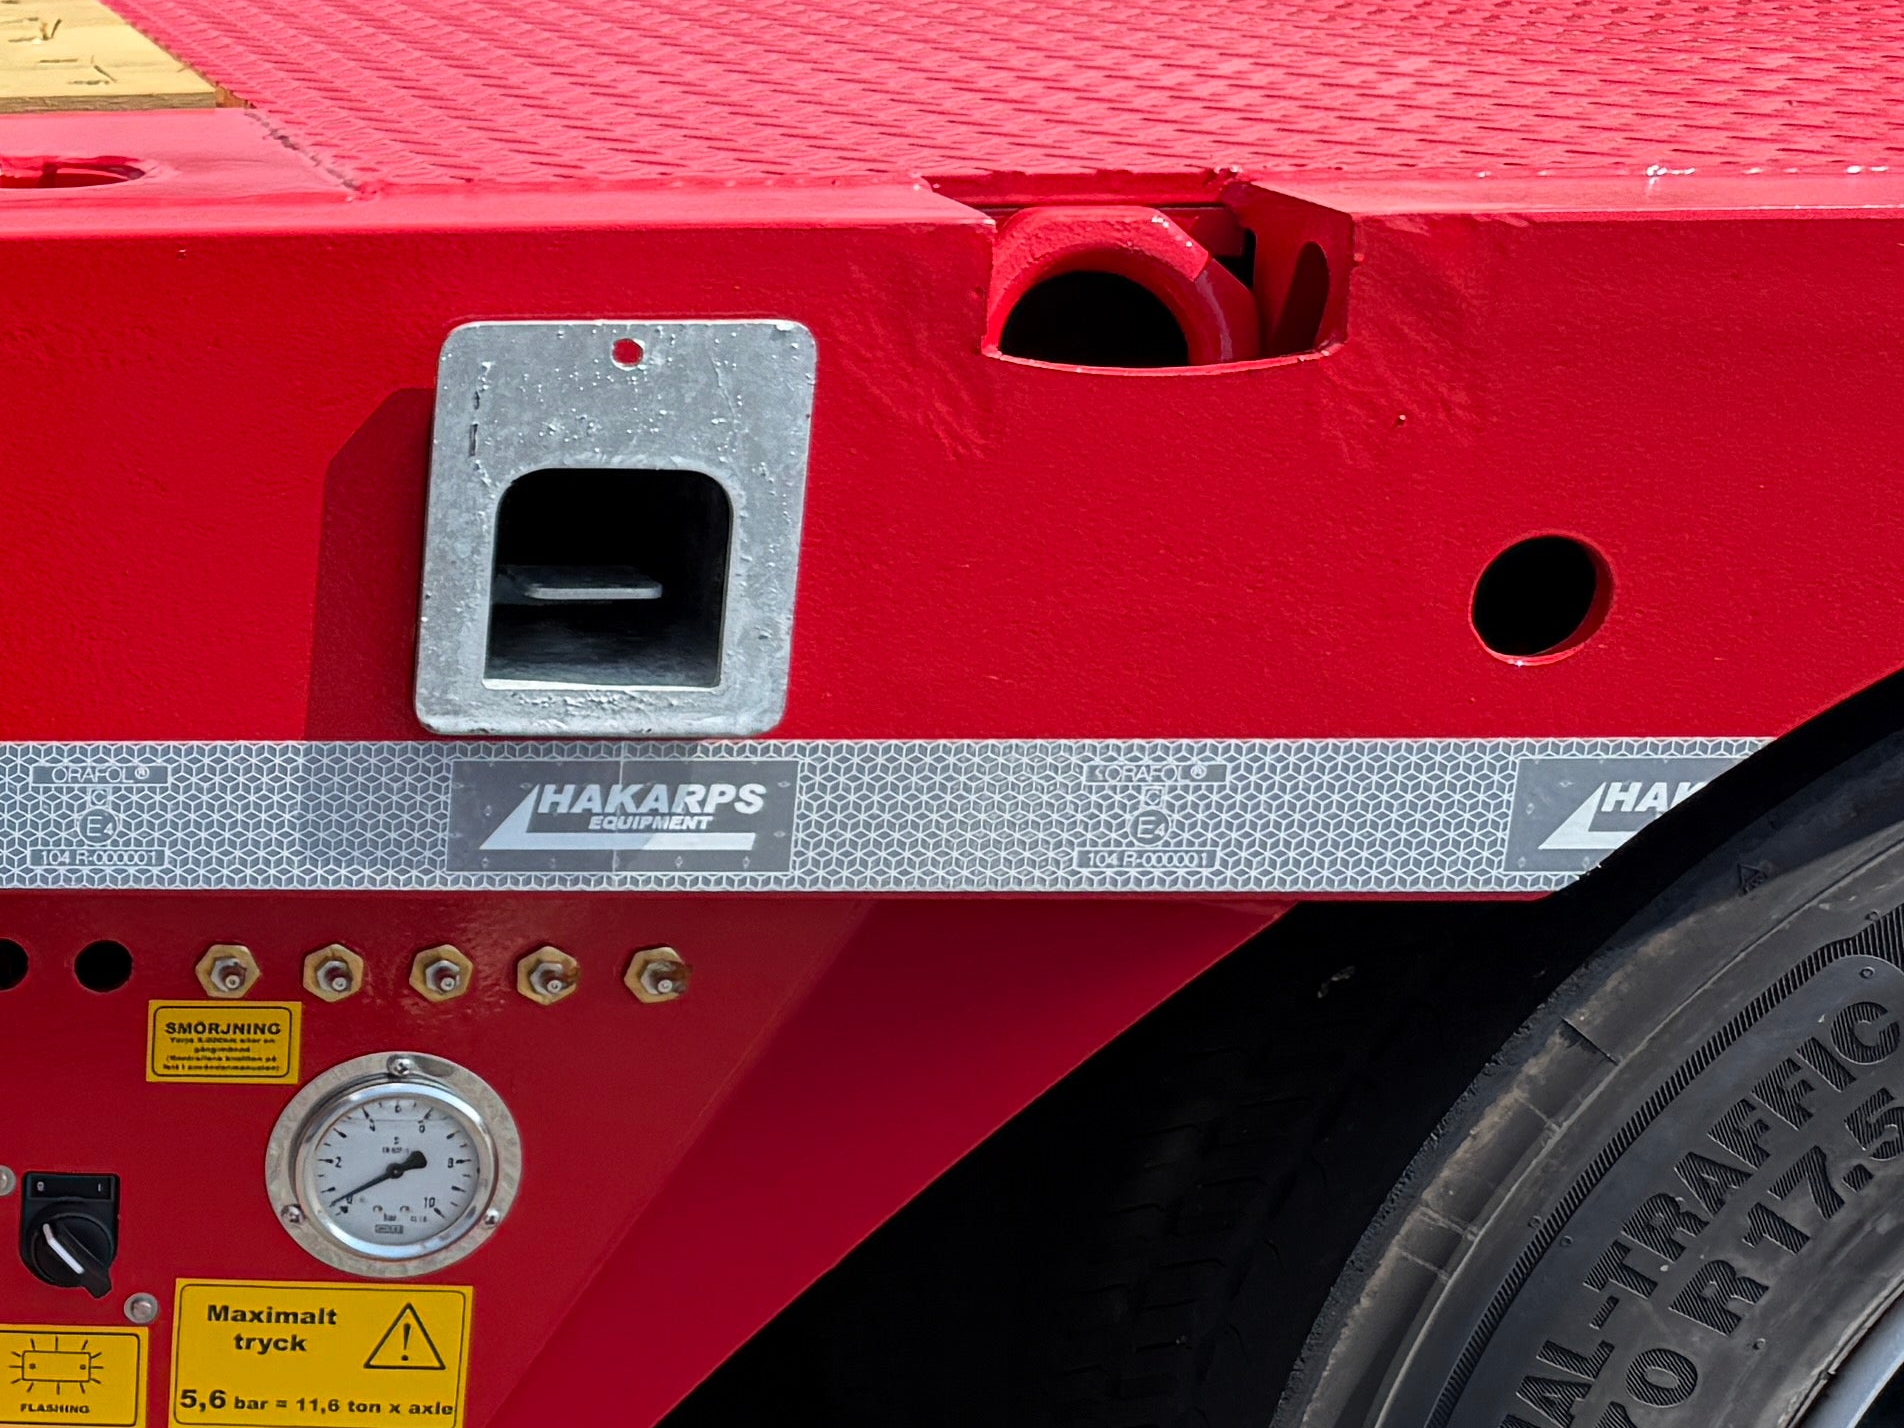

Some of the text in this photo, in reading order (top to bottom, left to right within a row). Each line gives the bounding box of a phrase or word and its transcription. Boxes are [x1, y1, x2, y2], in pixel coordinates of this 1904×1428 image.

[537, 783, 767, 814] HAKARPS
[587, 815, 714, 831] EQUIPMENT
[335, 1156, 342, 1169] 2
[423, 1197, 436, 1209] 10
[1669, 1259, 1769, 1337] R
[207, 1303, 338, 1325] Maximalt
[234, 1332, 307, 1355] tryck
[20, 1403, 90, 1415] FLASHING
[179, 1388, 227, 1413] 5,6
[234, 1395, 270, 1411] bar
[296, 1397, 341, 1415] 11,6
[348, 1400, 382, 1413] ton
[389, 1403, 402, 1415] x
[408, 1401, 454, 1416] axle
